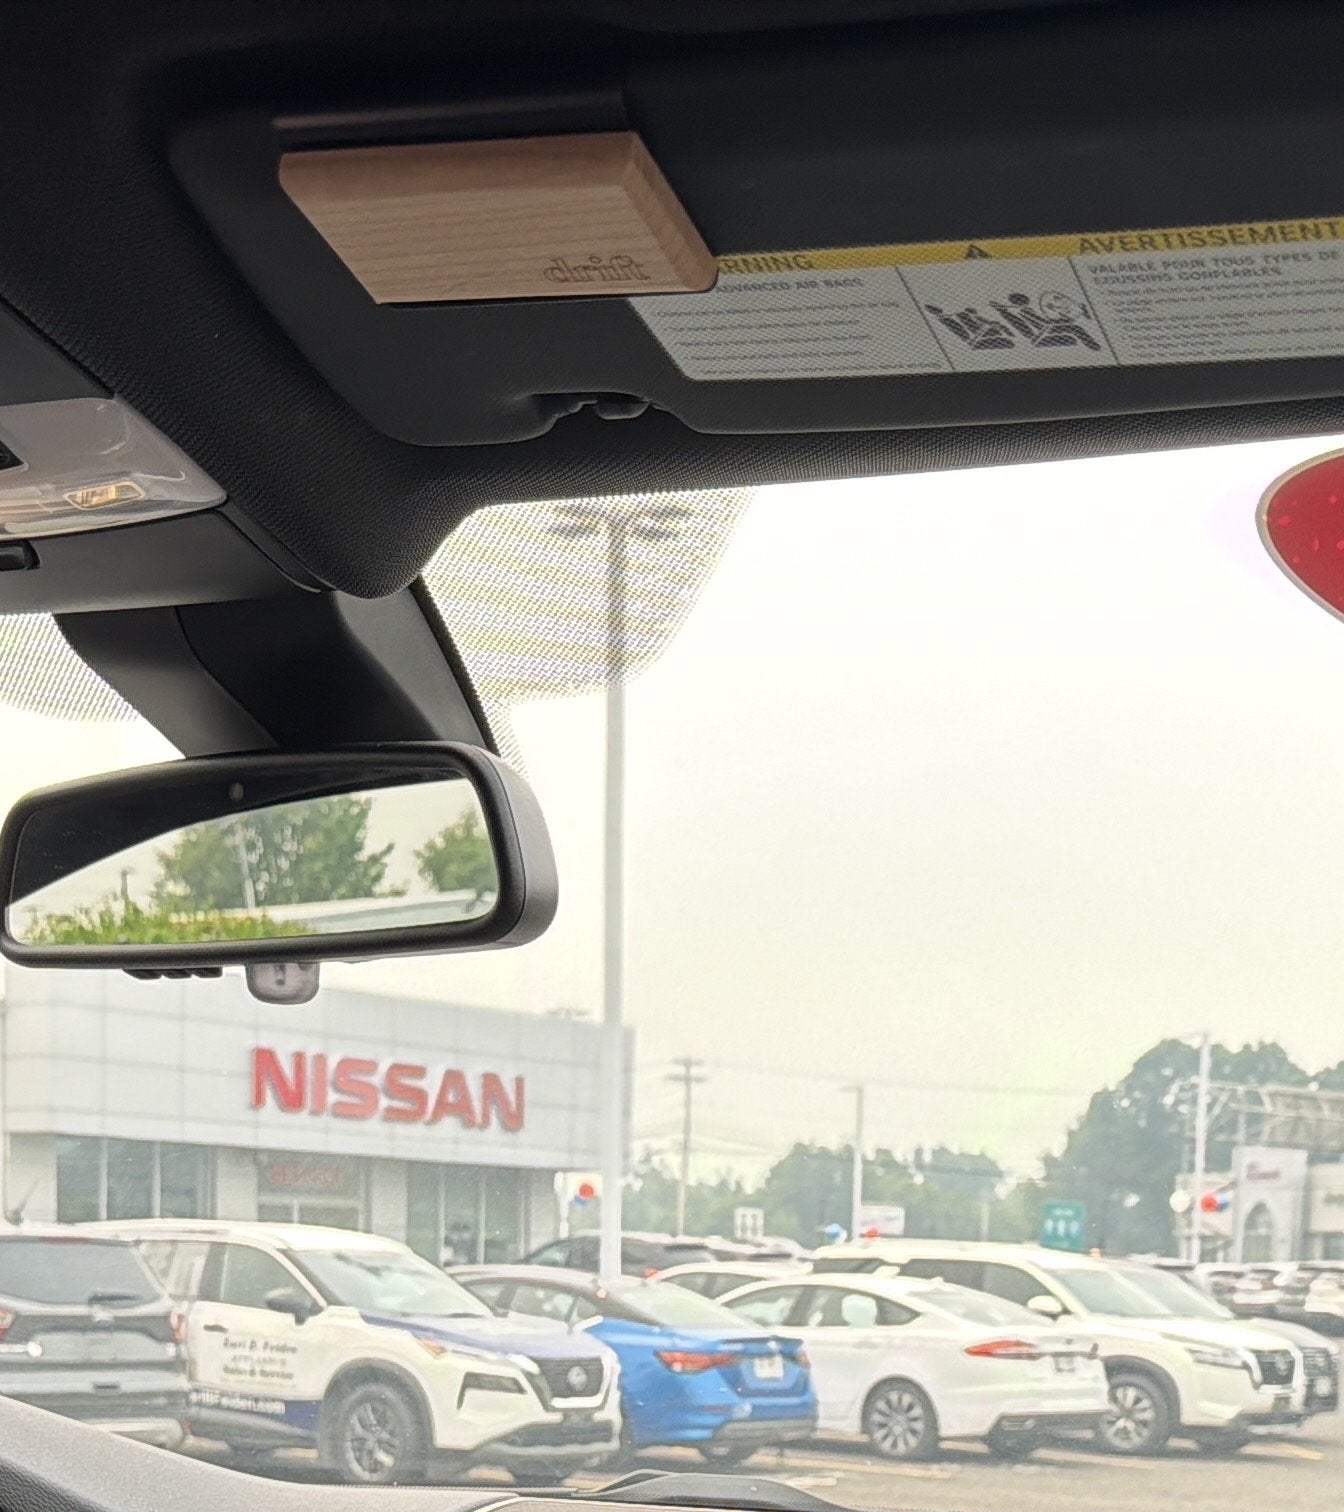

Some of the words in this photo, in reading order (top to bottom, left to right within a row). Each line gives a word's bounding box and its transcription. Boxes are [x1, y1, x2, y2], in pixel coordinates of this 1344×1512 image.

[1079, 221, 1340, 255] AVERTISSEMENT
[543, 255, 650, 283] drift
[718, 254, 814, 274] RNING
[250, 1047, 526, 1132] NISSAN
